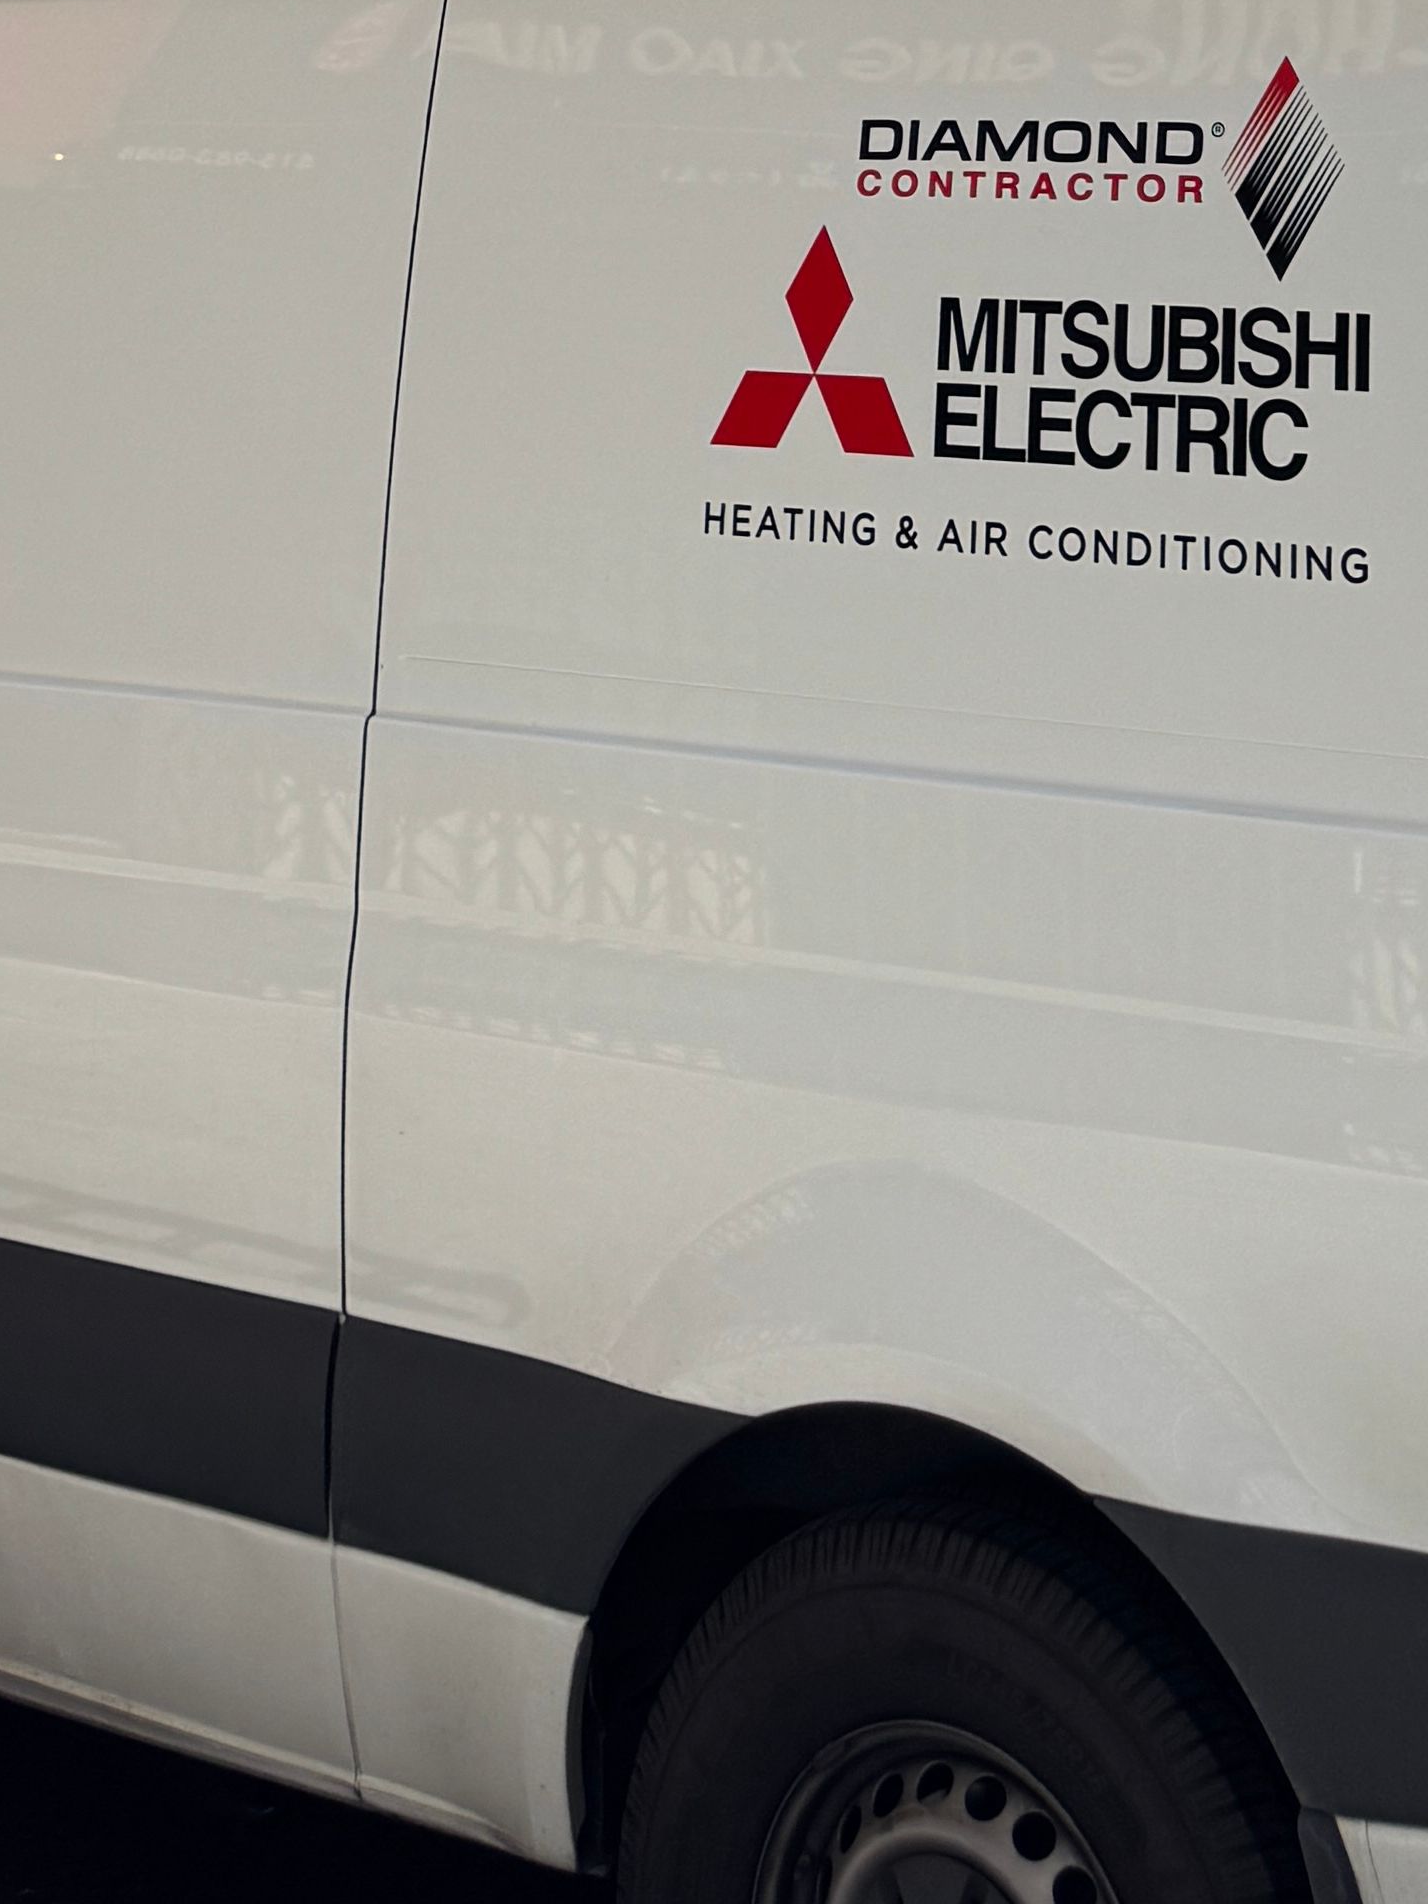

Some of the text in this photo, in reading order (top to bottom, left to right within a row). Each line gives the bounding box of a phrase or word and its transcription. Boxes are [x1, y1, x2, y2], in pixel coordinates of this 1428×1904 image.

[856, 168, 1204, 204] CONTRACTOR
[936, 296, 1371, 393] MITSUBISHI
[932, 383, 1309, 481] ELECTRIC
[703, 501, 1370, 584] HEATING & AIR CONDITIONING
